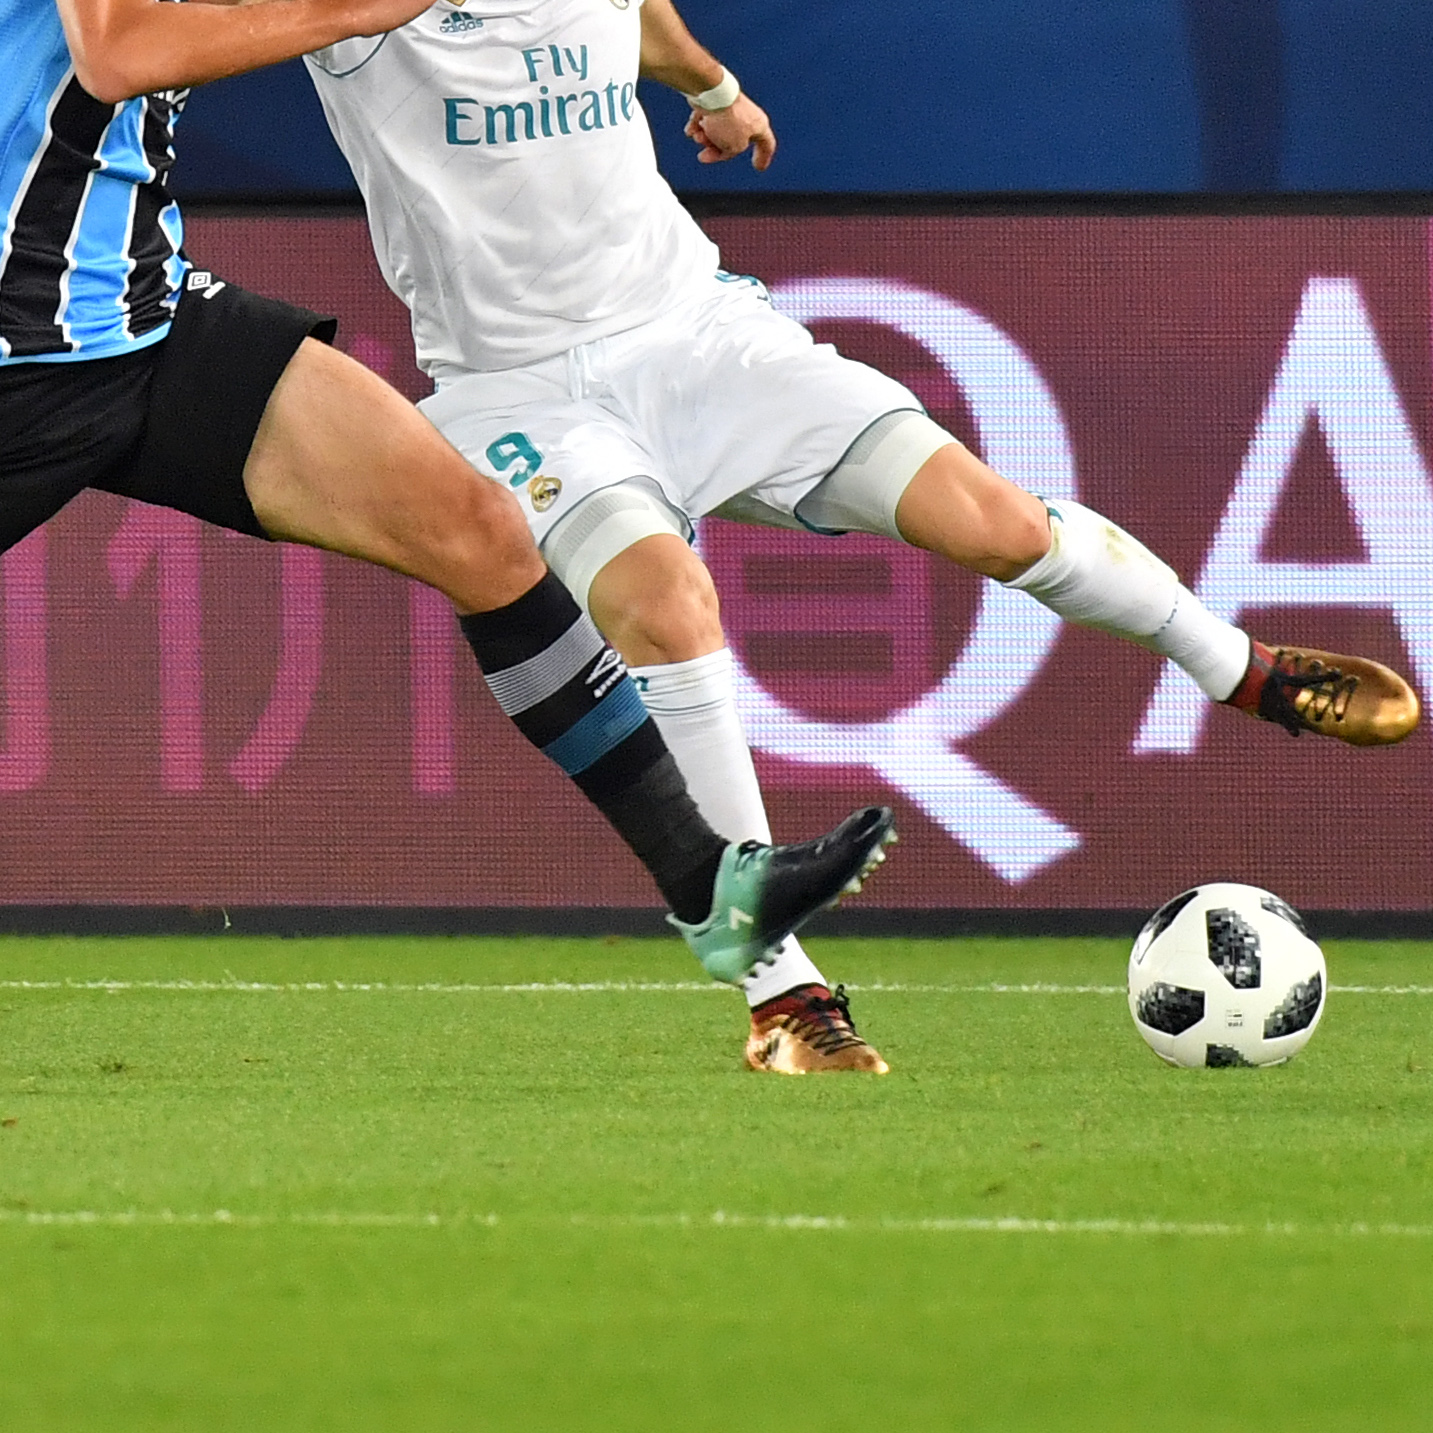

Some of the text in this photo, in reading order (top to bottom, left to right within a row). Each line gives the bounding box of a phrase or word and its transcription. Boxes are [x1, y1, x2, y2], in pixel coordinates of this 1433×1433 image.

[439, 18, 484, 34] adidas
[521, 44, 588, 82] Fly
[442, 79, 635, 146] Emirate
[485, 431, 543, 488] 9
